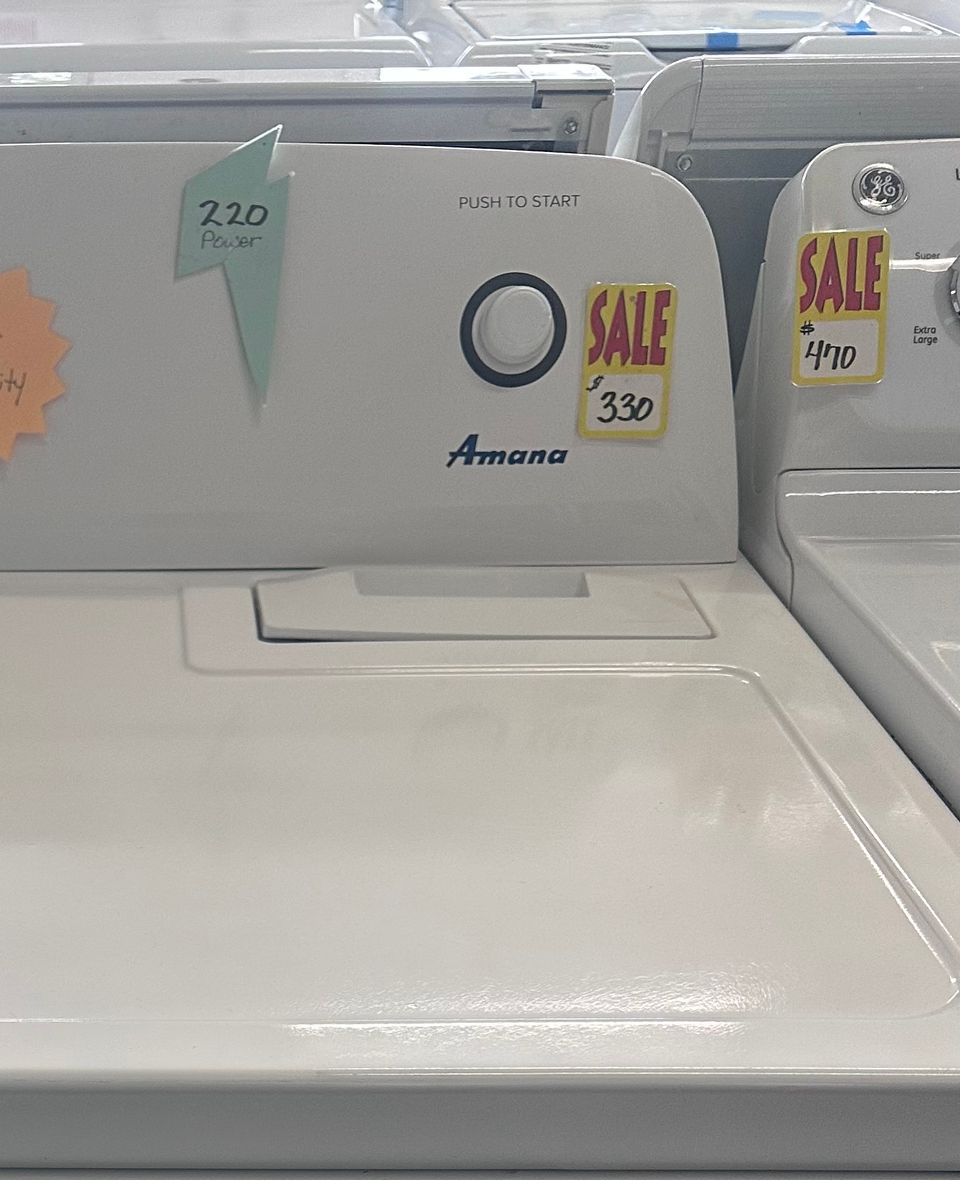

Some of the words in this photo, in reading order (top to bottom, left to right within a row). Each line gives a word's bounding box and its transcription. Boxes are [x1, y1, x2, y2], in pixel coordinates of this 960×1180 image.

[199, 199, 269, 227] 220
[459, 196, 502, 209] PUSH
[506, 195, 528, 208] TO
[532, 194, 581, 208] START
[914, 251, 941, 261] Super
[799, 234, 884, 315] SALE
[587, 289, 672, 367] SALE
[913, 325, 937, 335] Extra
[913, 335, 938, 346] Large
[804, 339, 857, 371] 470
[596, 391, 654, 424] 330
[446, 433, 569, 469] Amana
